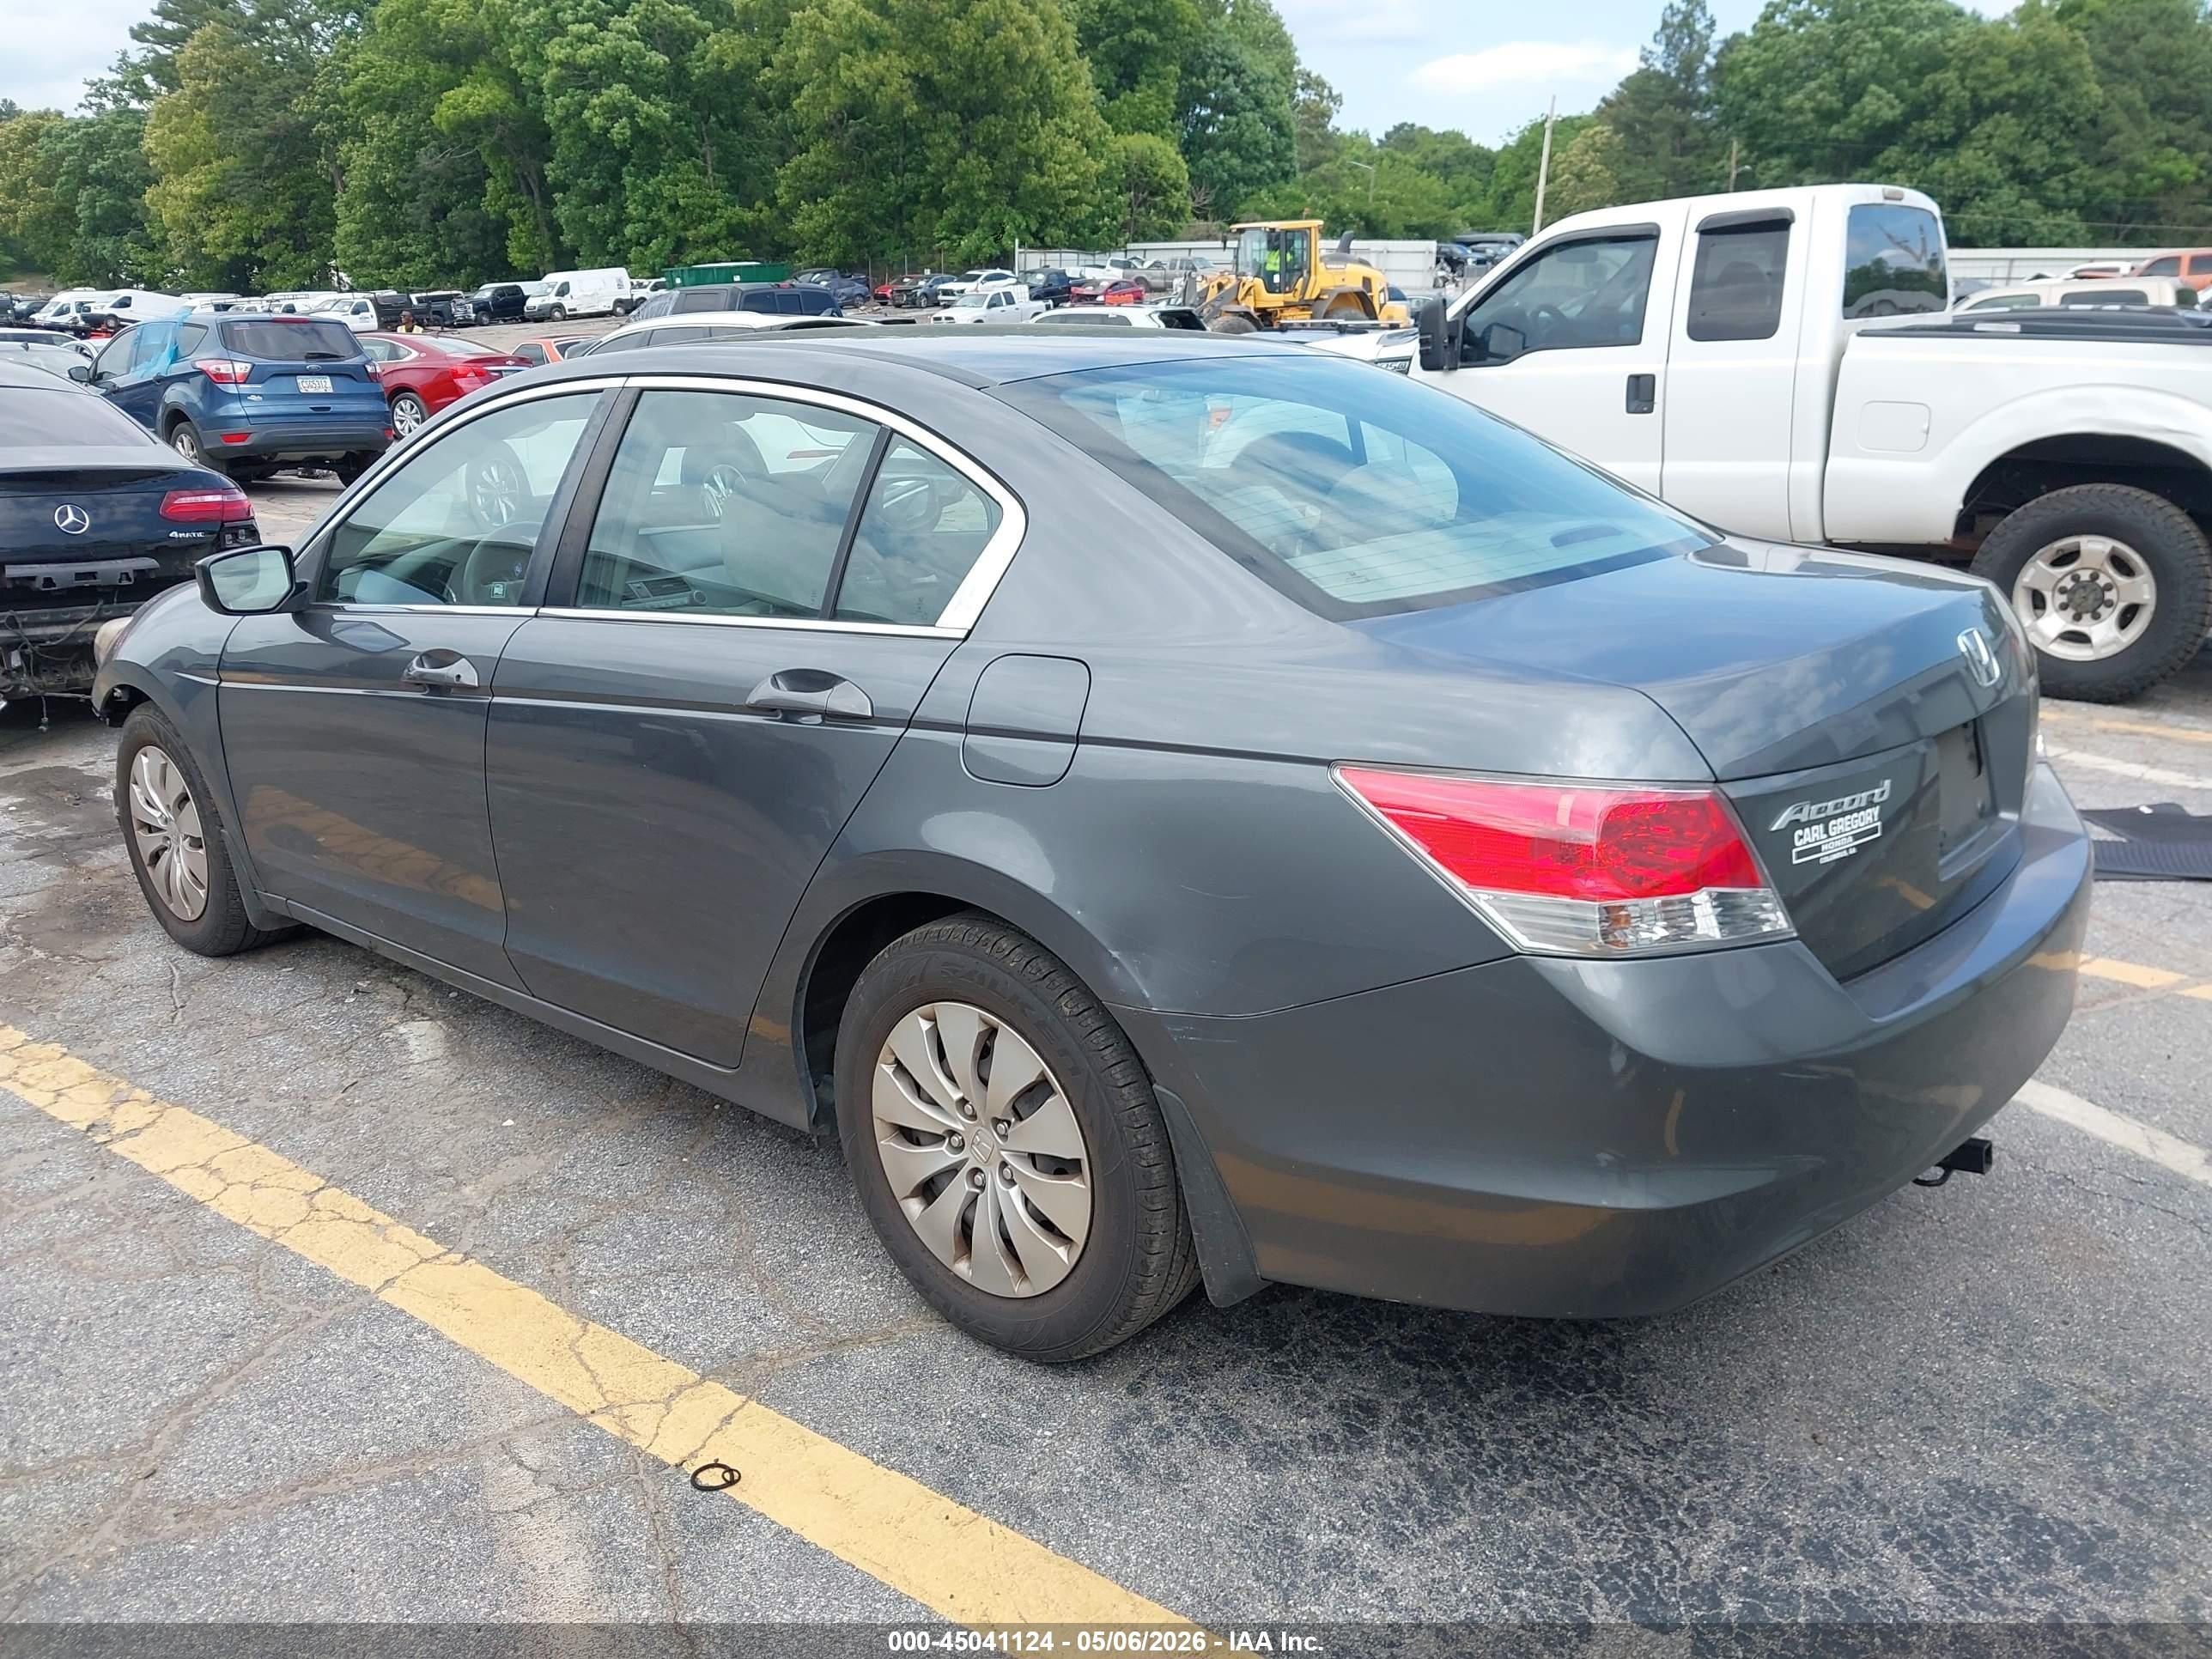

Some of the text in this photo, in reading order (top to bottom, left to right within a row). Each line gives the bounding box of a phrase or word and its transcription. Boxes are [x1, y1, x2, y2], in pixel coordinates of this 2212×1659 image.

[1769, 779, 1892, 831] Accord
[1794, 805, 1881, 847] CARL GREGORY
[1821, 836, 1854, 852] HONDA
